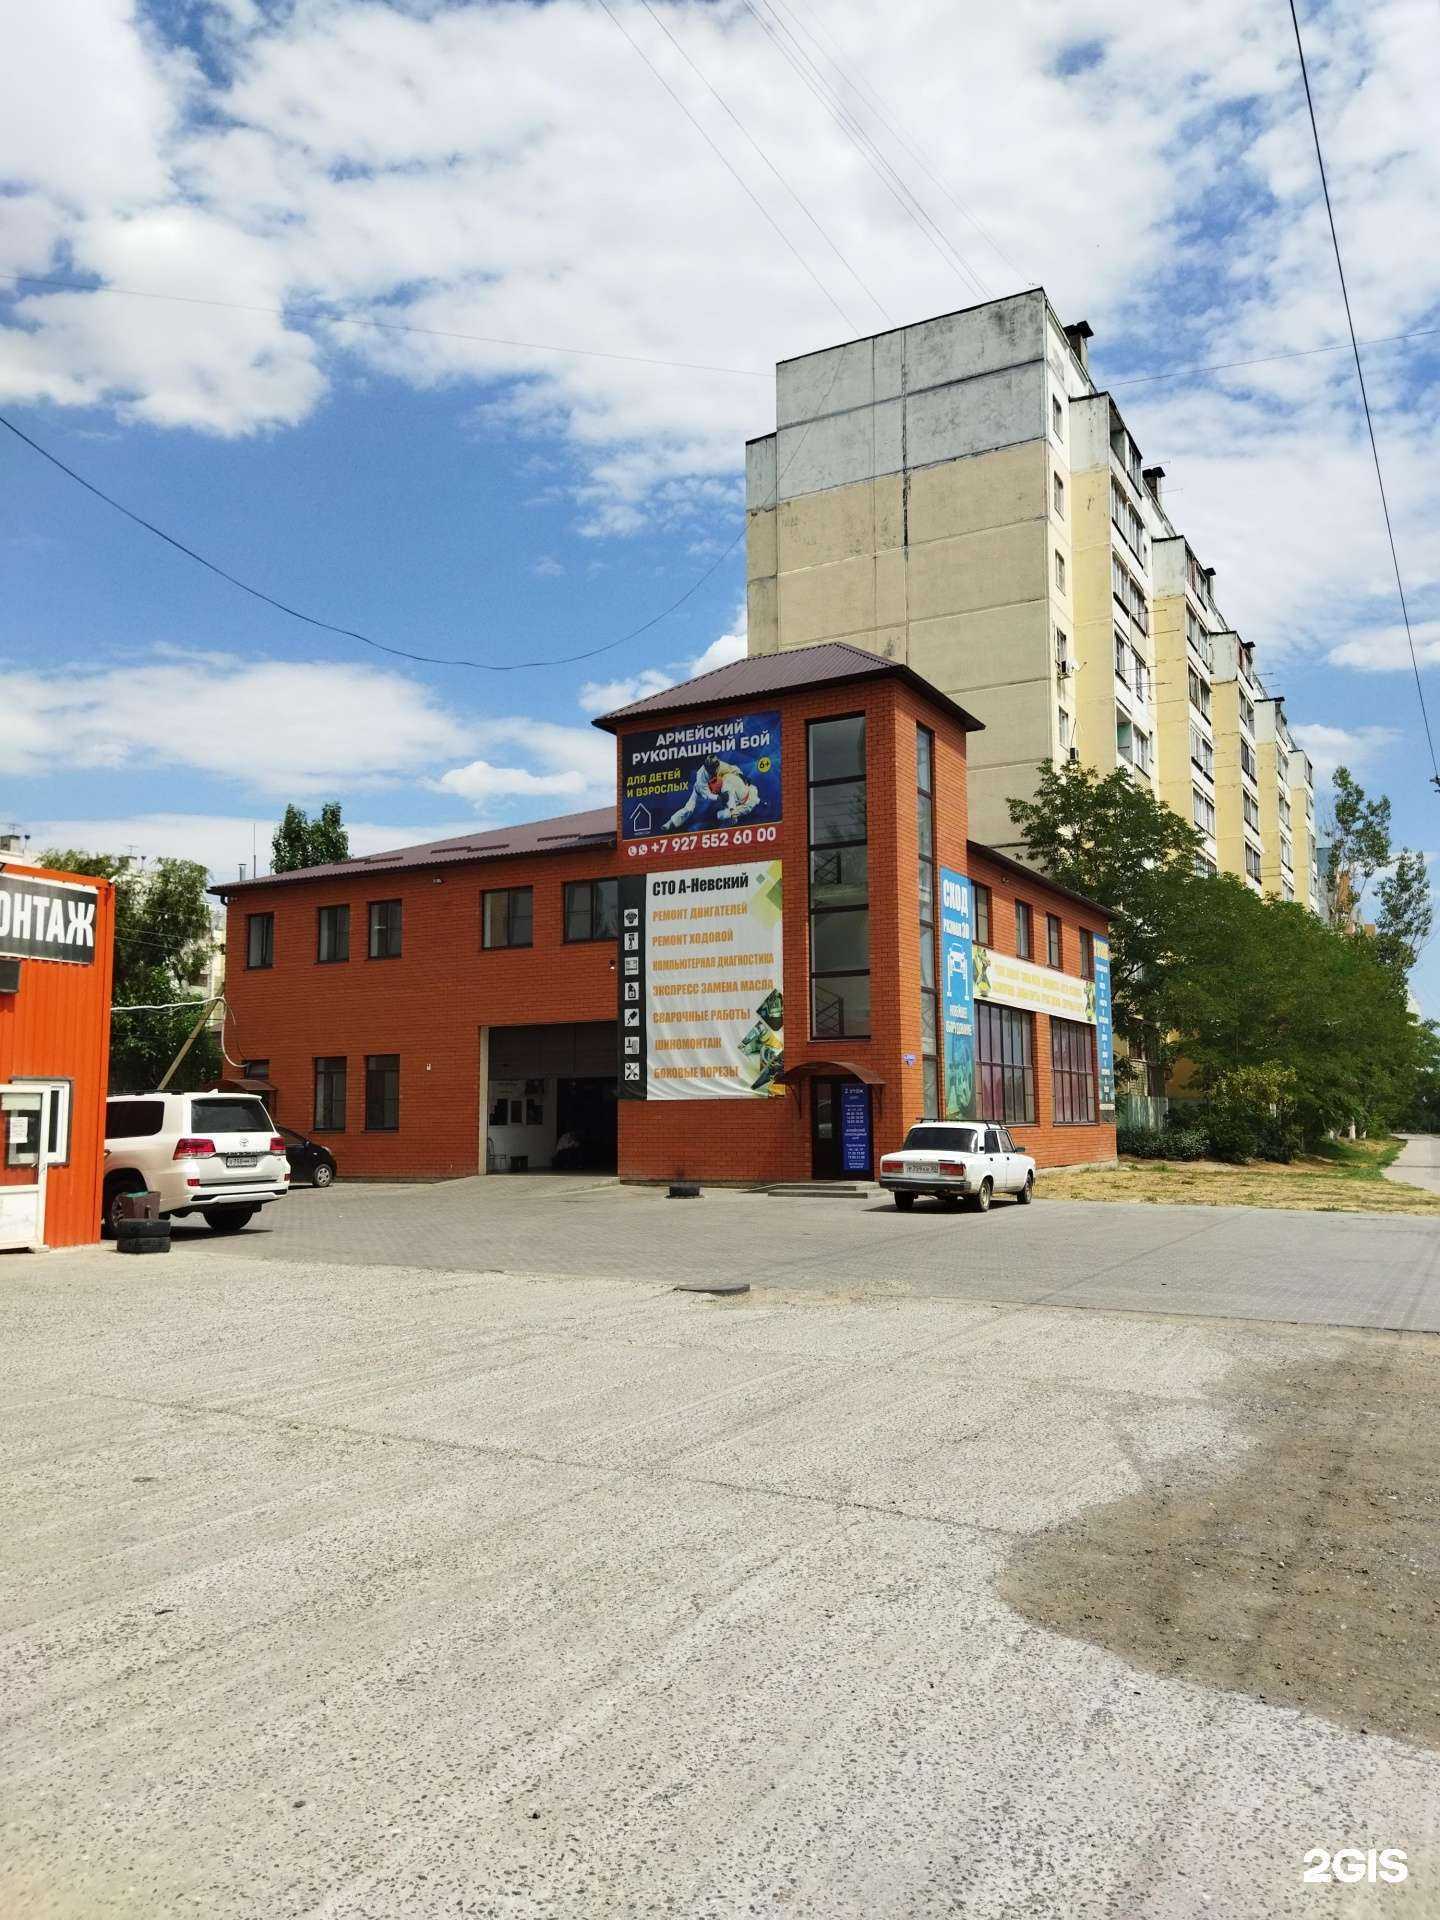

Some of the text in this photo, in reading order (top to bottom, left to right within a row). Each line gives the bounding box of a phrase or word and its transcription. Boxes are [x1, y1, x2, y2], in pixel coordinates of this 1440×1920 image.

[656, 719, 744, 747] АРМЕЙСКИЙ
[632, 730, 770, 765] РУКОПАШНЫЙ БОЙ
[759, 759, 770, 770] 6+
[627, 768, 681, 786] ДЛЯ ДЕТЕЙ
[627, 781, 689, 798] И ВЗРОСЛЫХ
[651, 826, 776, 853] +7 927 552 60 00
[652, 880, 676, 896] СТО
[943, 879, 969, 918] СХОД
[652, 901, 748, 922] РЕМОНТ ДВИГАТЕЛЕЙ
[652, 928, 734, 947] РЕМОНТ ХОДОВОЙ
[717, 952, 774, 968] ДИАГНОСТИКА
[652, 979, 774, 996] ЭКСПРЕСС ЗАМЕНА МАСЛА
[653, 1008, 751, 1024] СВАРОЧНЫЕ РАБОТЫ
[655, 1037, 722, 1050] ШИНОМОНТАЖ
[654, 1066, 739, 1079] БОКОВЫЕ ПОРЕЗЫ
